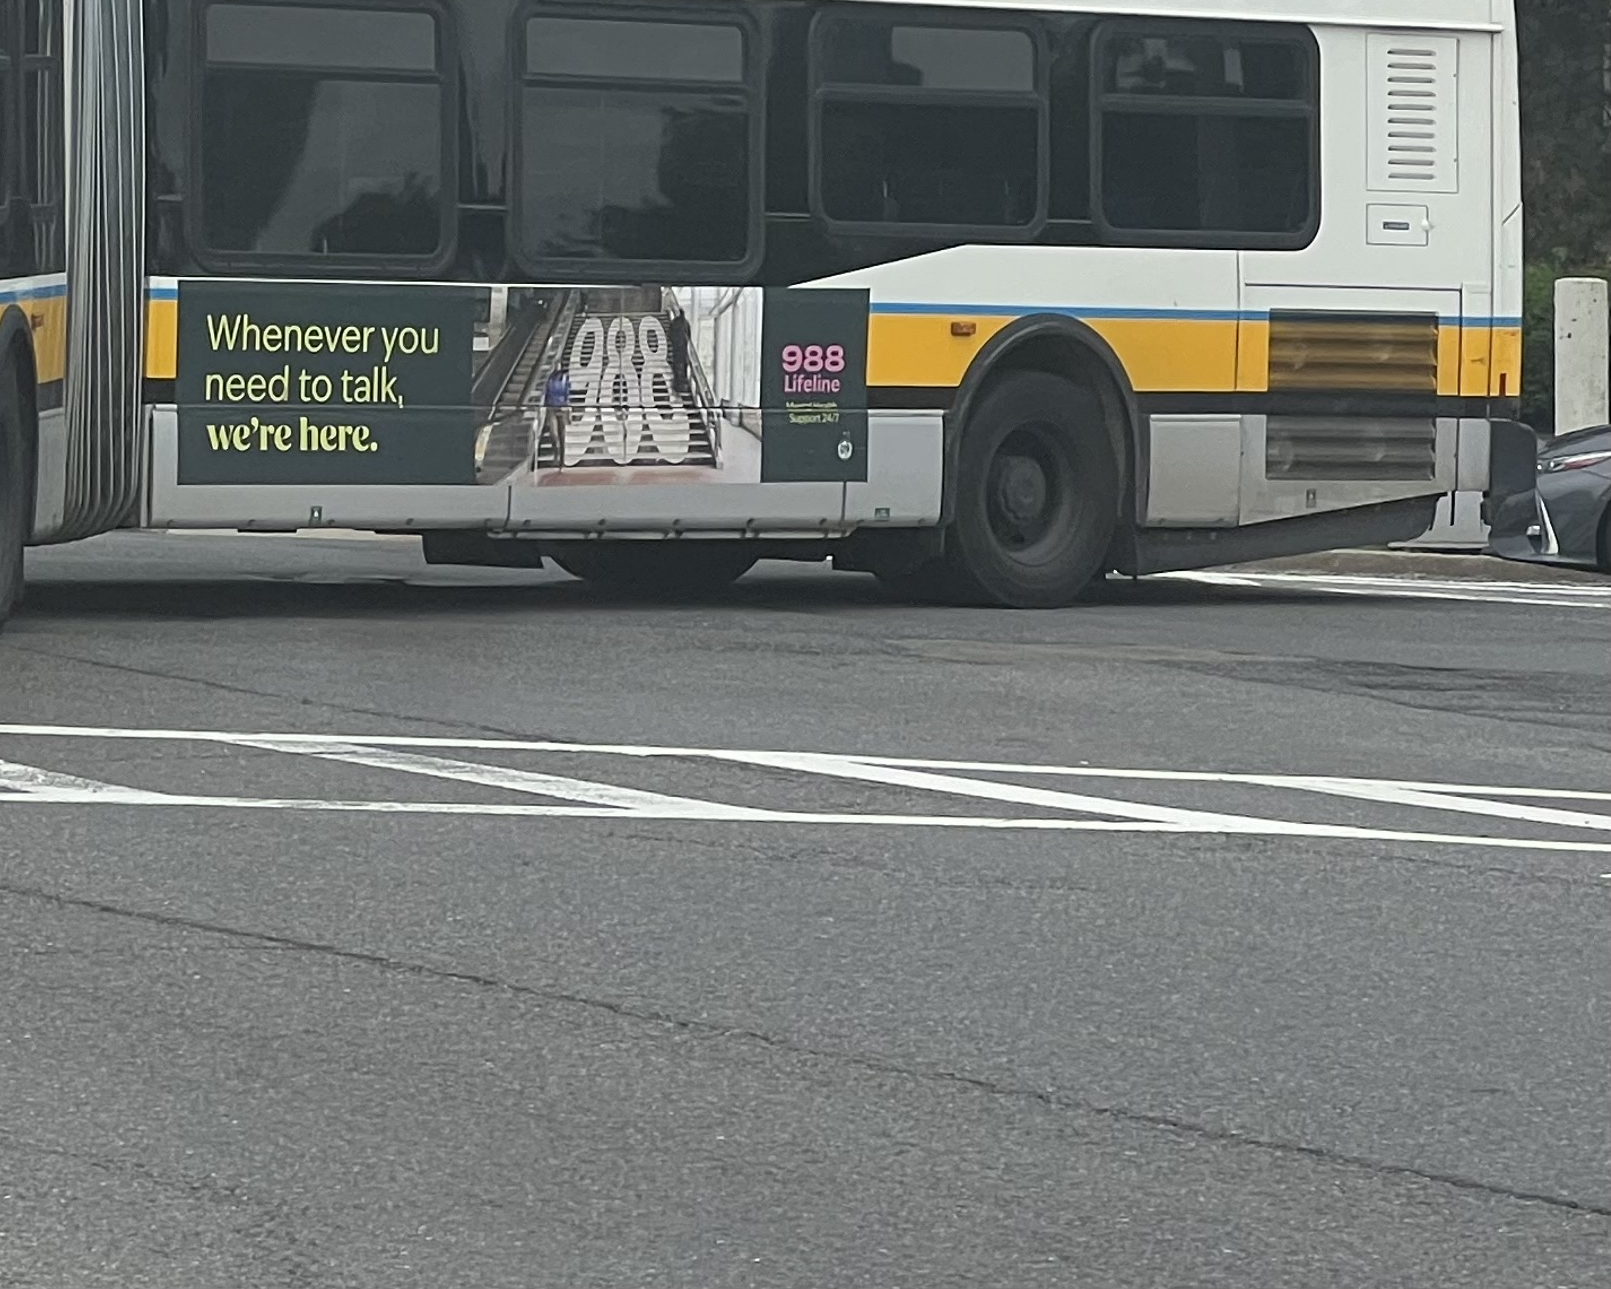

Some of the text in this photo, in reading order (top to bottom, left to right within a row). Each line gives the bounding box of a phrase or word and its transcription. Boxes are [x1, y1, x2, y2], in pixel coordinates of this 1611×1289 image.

[207, 314, 439, 363] Whenever you
[782, 345, 845, 372] 988
[205, 365, 404, 409] need to talk,
[784, 374, 840, 393] Lifeline
[299, 417, 378, 452] here.
[789, 413, 821, 425] Support
